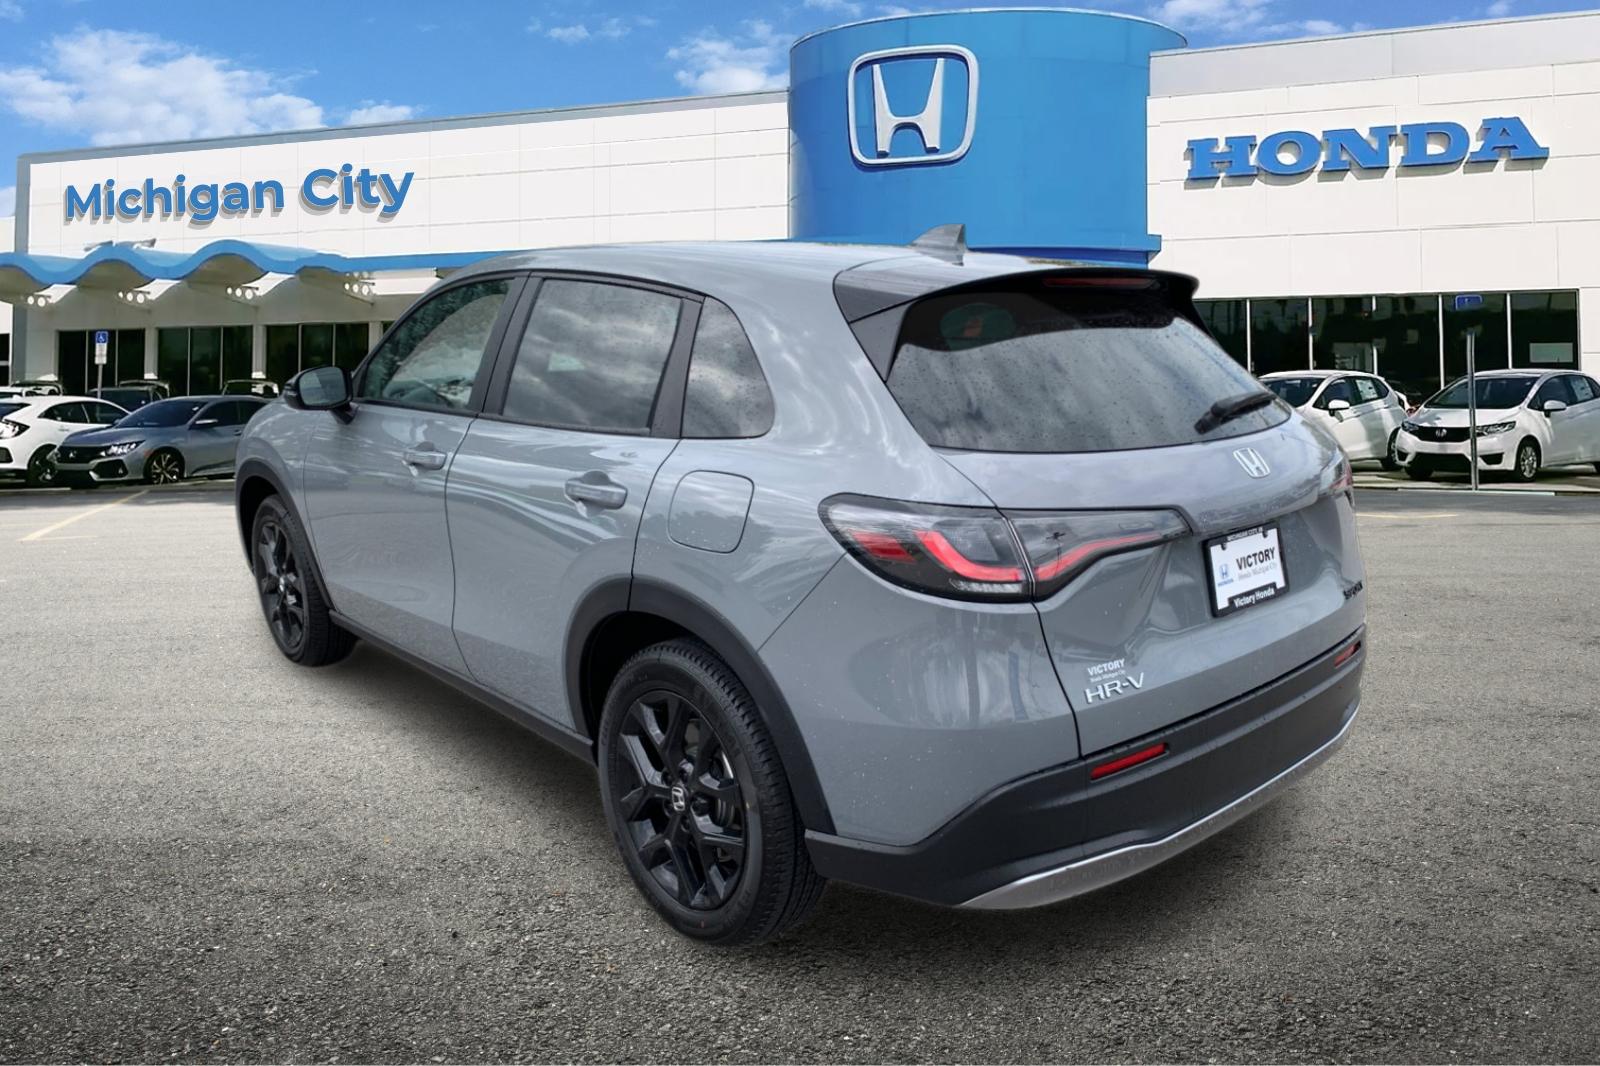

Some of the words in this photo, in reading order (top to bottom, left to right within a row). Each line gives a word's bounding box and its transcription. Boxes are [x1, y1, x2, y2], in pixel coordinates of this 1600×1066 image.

[1186, 116, 1551, 182] HONDA
[67, 174, 285, 222] Michigan
[303, 163, 415, 214] City
[1236, 547, 1275, 570] VICTORY
[1234, 595, 1256, 608] Victory
[1255, 587, 1275, 600] Honda
[1087, 658, 1125, 676] VICTORY
[1084, 672, 1144, 704] HR-V
